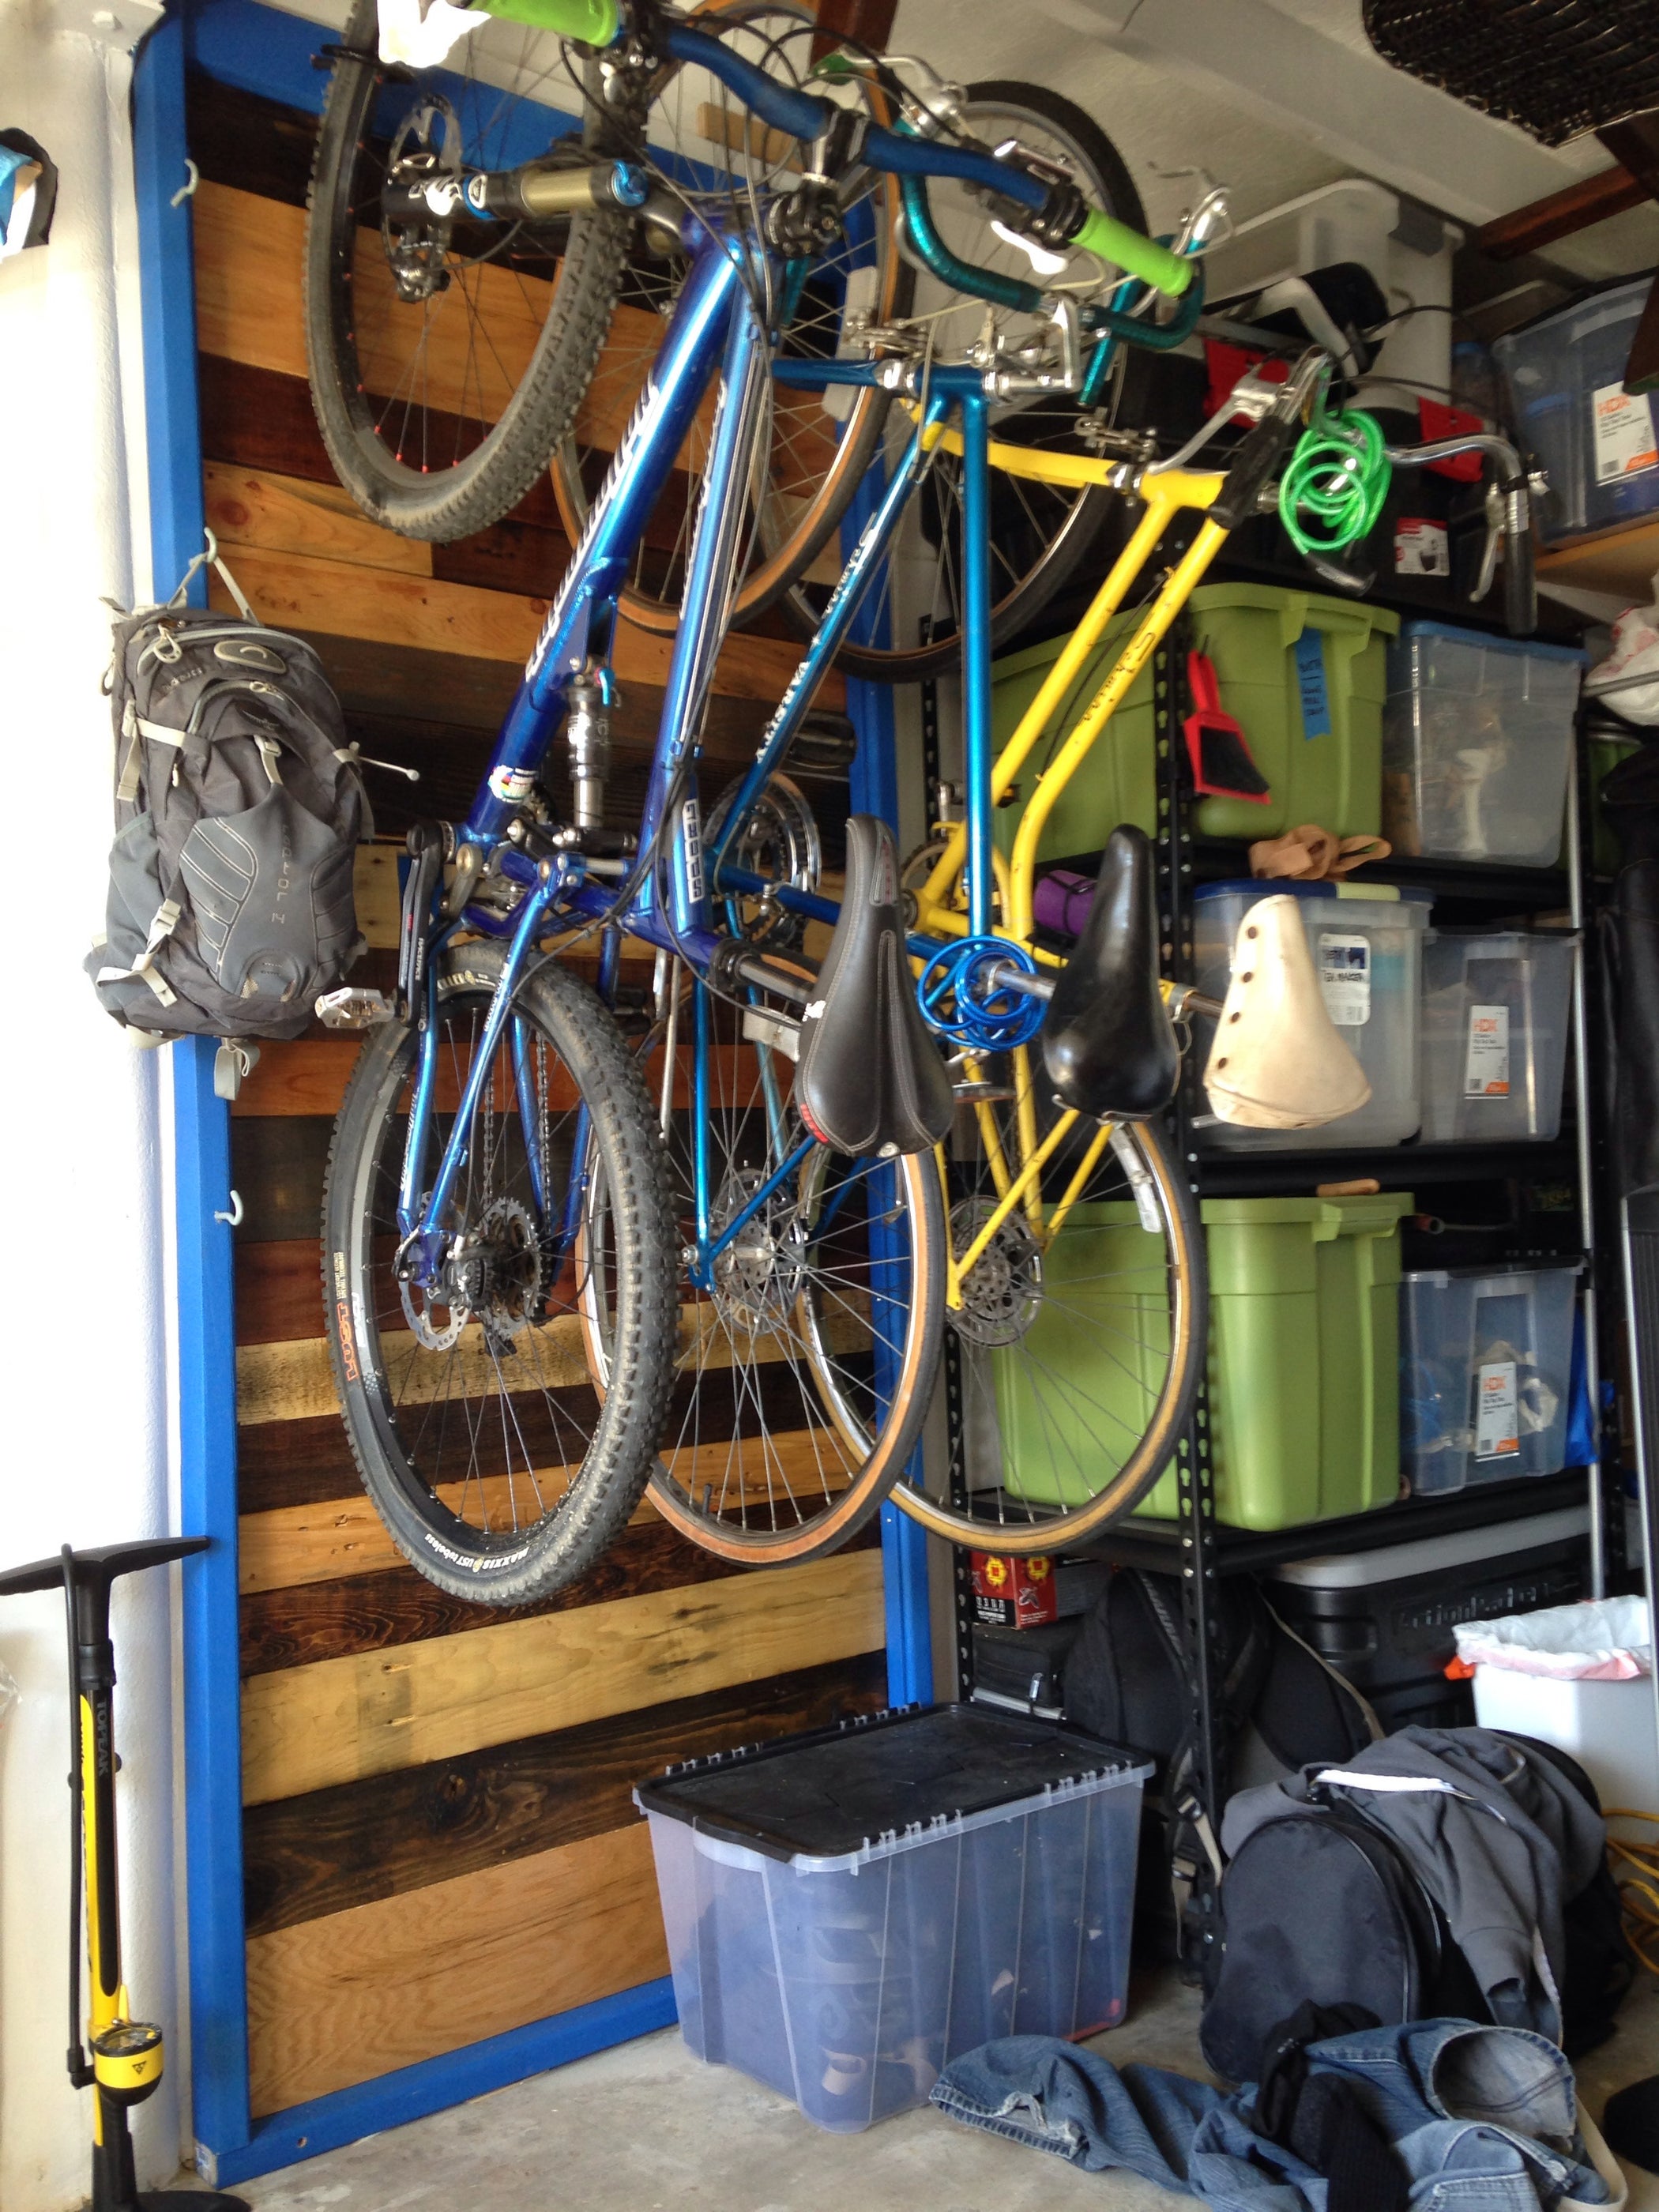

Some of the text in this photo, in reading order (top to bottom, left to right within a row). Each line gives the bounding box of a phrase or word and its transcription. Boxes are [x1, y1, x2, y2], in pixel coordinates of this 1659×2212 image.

[337, 1302, 359, 1381] LUST
[424, 1533, 530, 1570] MAXXIS UST tubeless
[96, 1698, 109, 1777] TOPEAK
